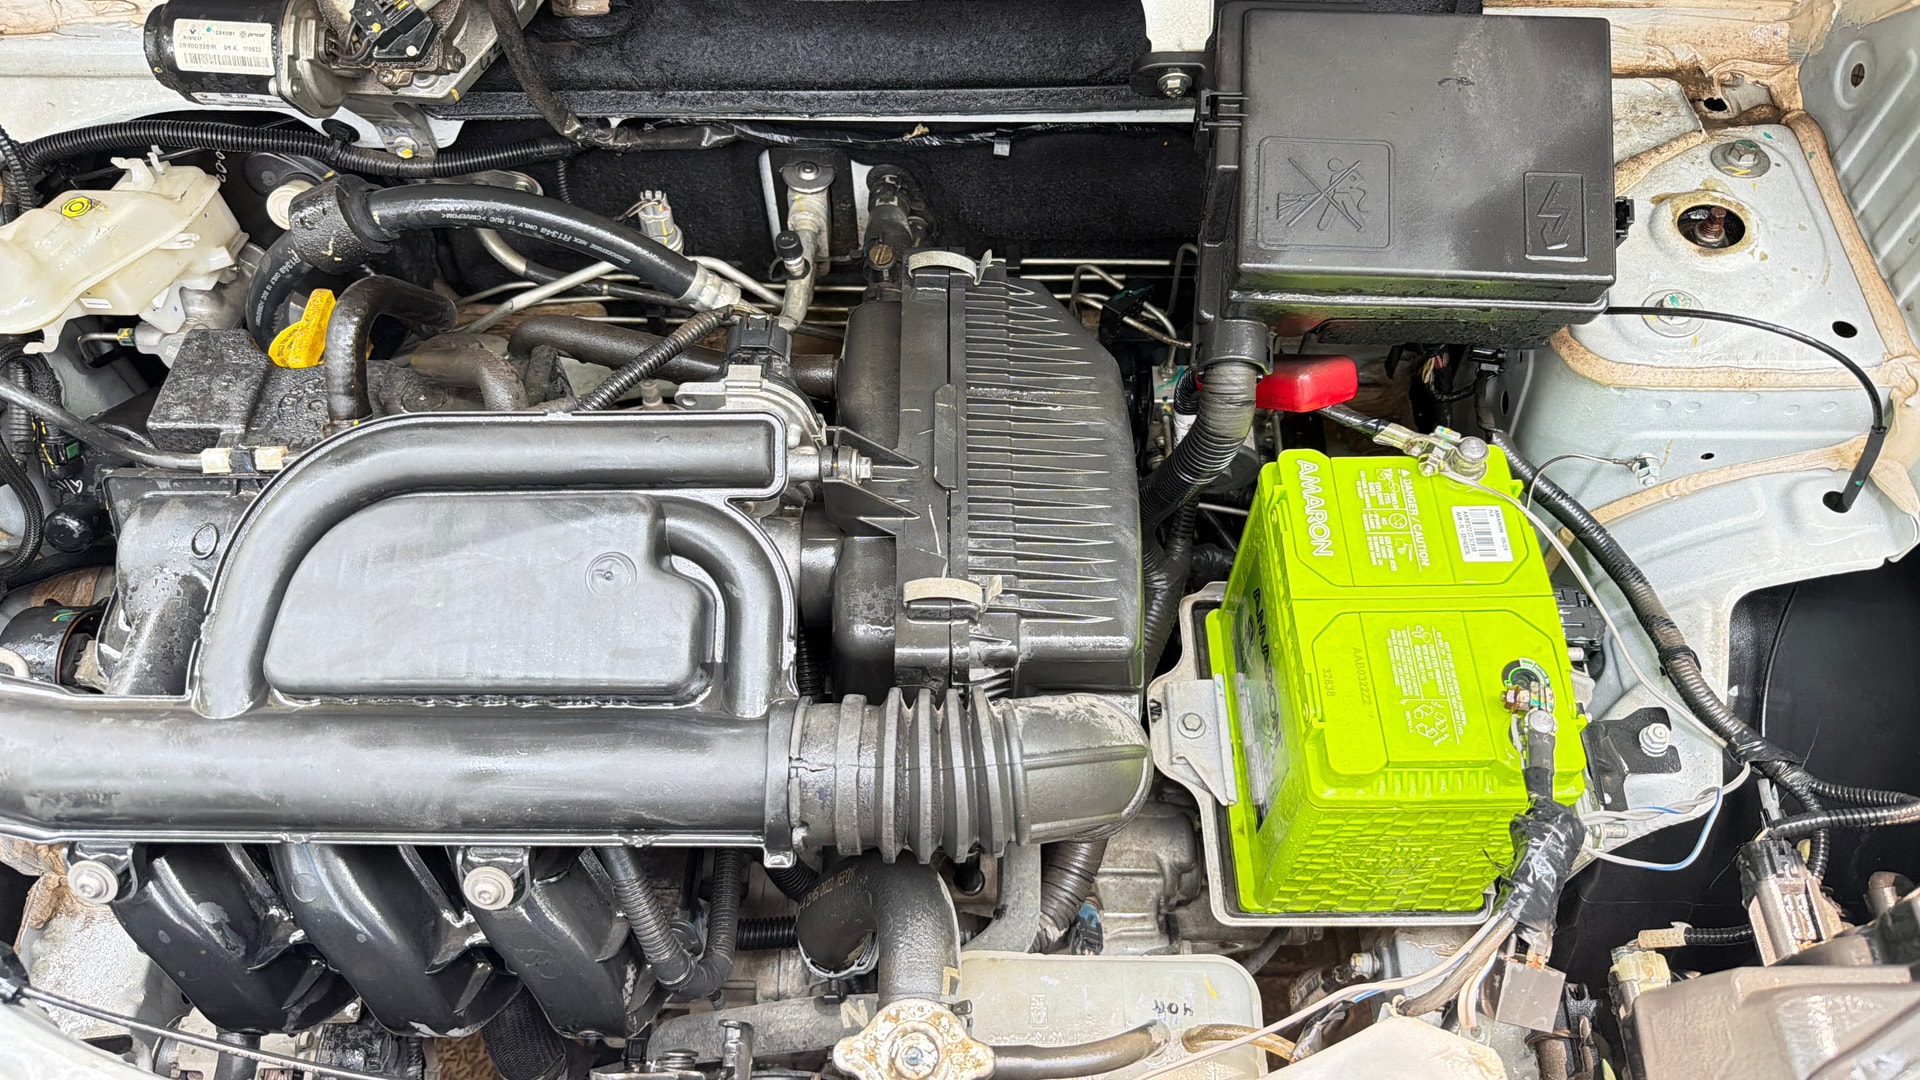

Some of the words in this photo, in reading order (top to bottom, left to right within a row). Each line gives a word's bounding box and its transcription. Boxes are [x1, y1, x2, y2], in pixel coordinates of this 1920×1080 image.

[518, 222, 538, 230] ONLY
[540, 227, 572, 242] R134a
[1296, 460, 1334, 556] AMARON
[1403, 478, 1419, 516] DANGER
[1413, 524, 1430, 566] CAUTION
[1253, 588, 1282, 749] AMARON
